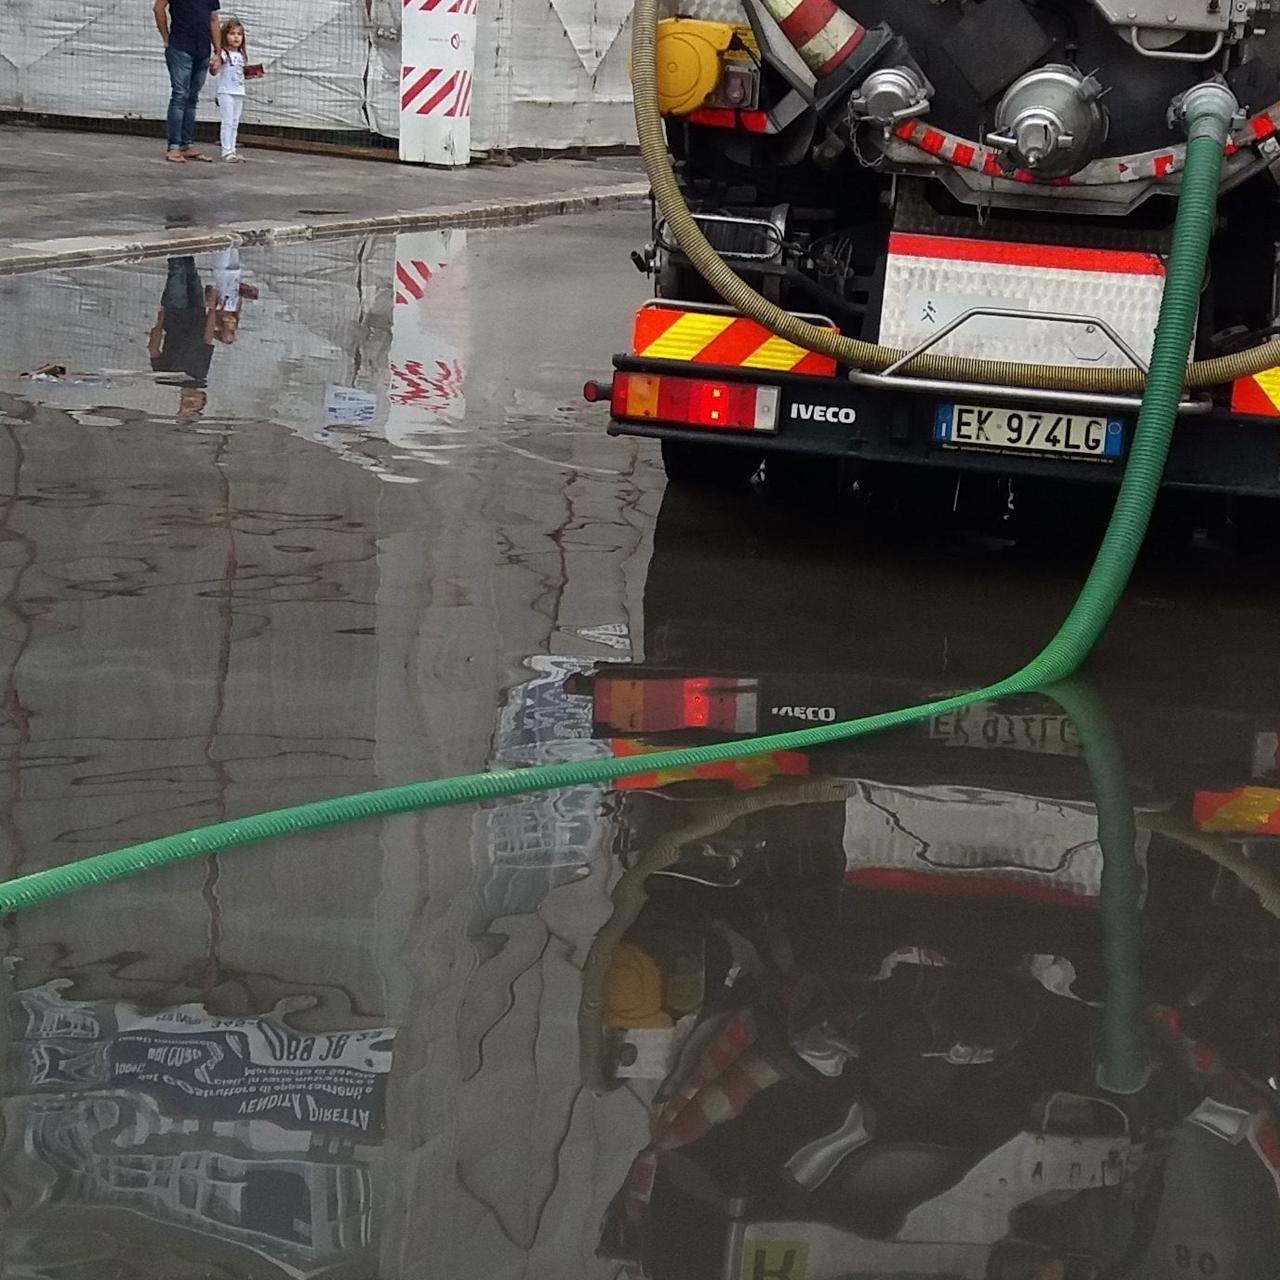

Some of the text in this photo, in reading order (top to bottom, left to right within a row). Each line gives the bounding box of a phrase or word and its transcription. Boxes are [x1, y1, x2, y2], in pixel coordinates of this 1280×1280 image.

[790, 402, 856, 424] IVECO
[956, 408, 994, 441] EK
[1005, 412, 1103, 451] 974LG
